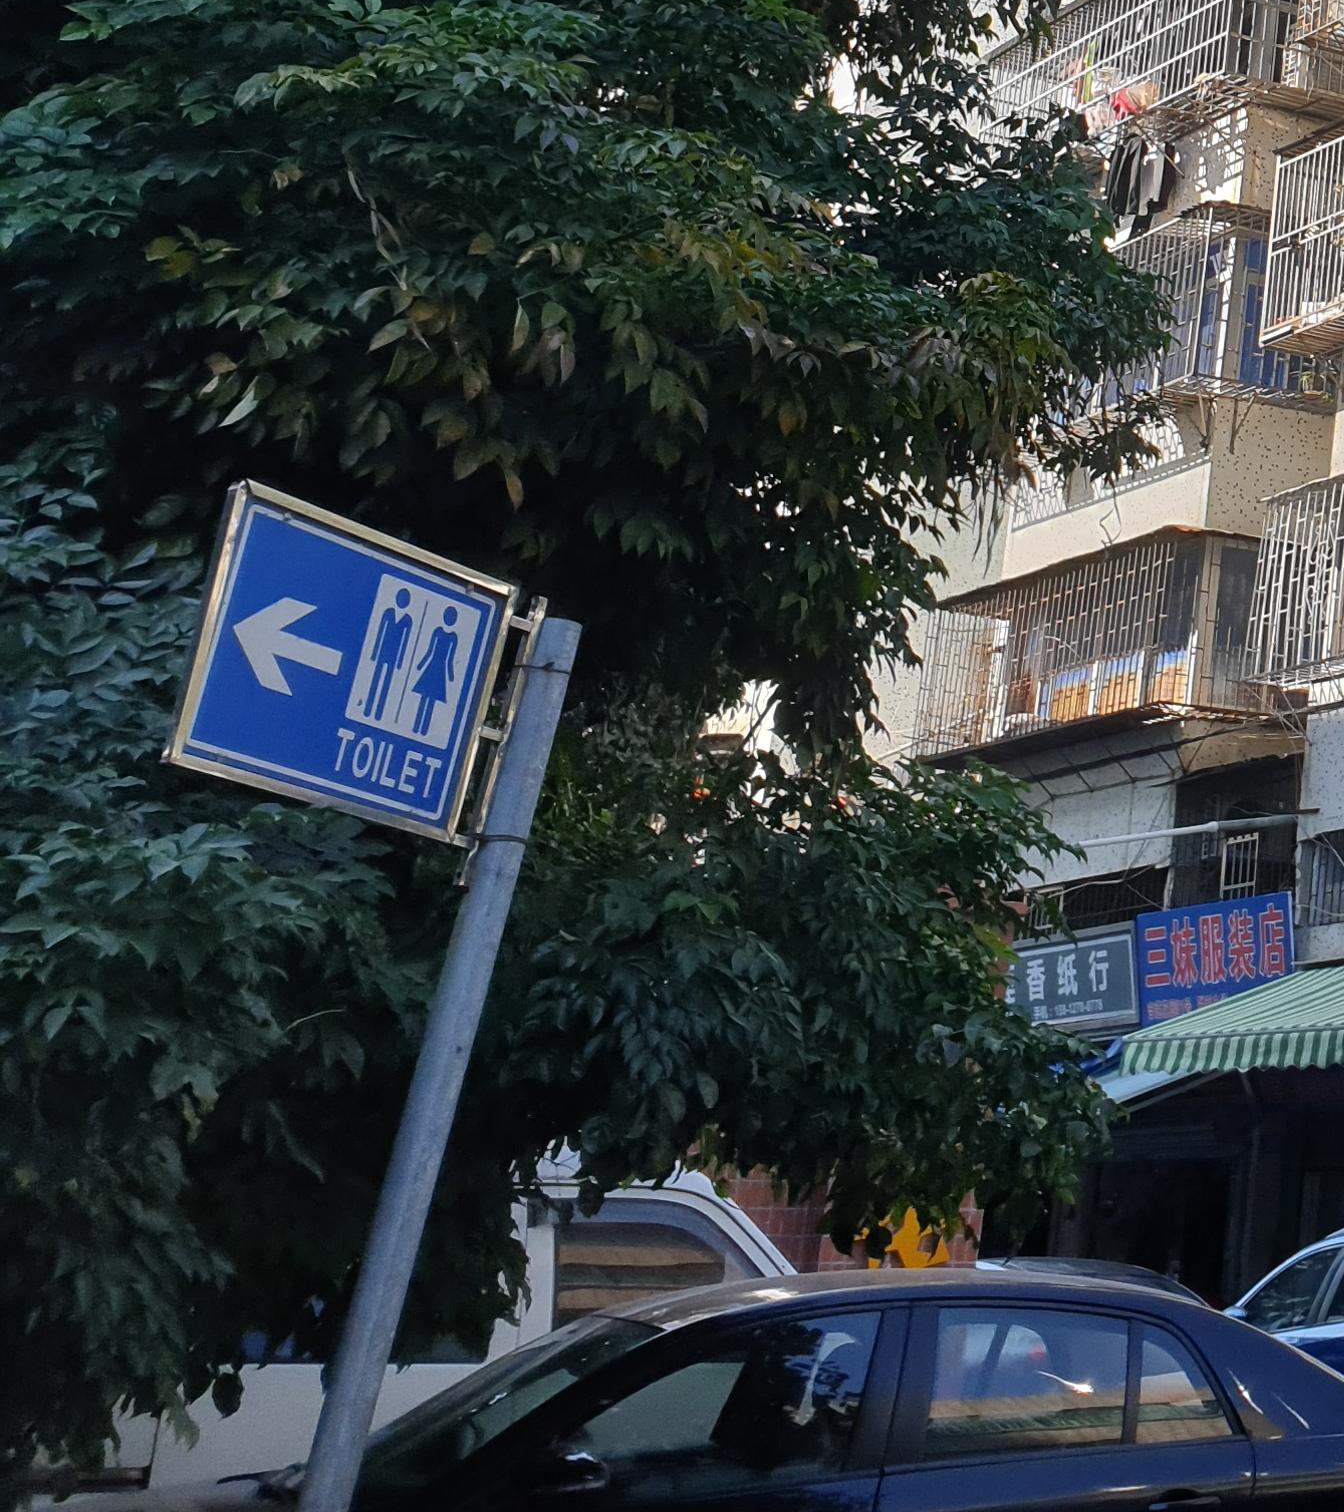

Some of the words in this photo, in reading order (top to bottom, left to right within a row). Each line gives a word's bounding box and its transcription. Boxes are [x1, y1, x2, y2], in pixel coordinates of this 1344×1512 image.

[333, 726, 442, 800] TOILET
[1144, 902, 1286, 989] 三妹服装店
